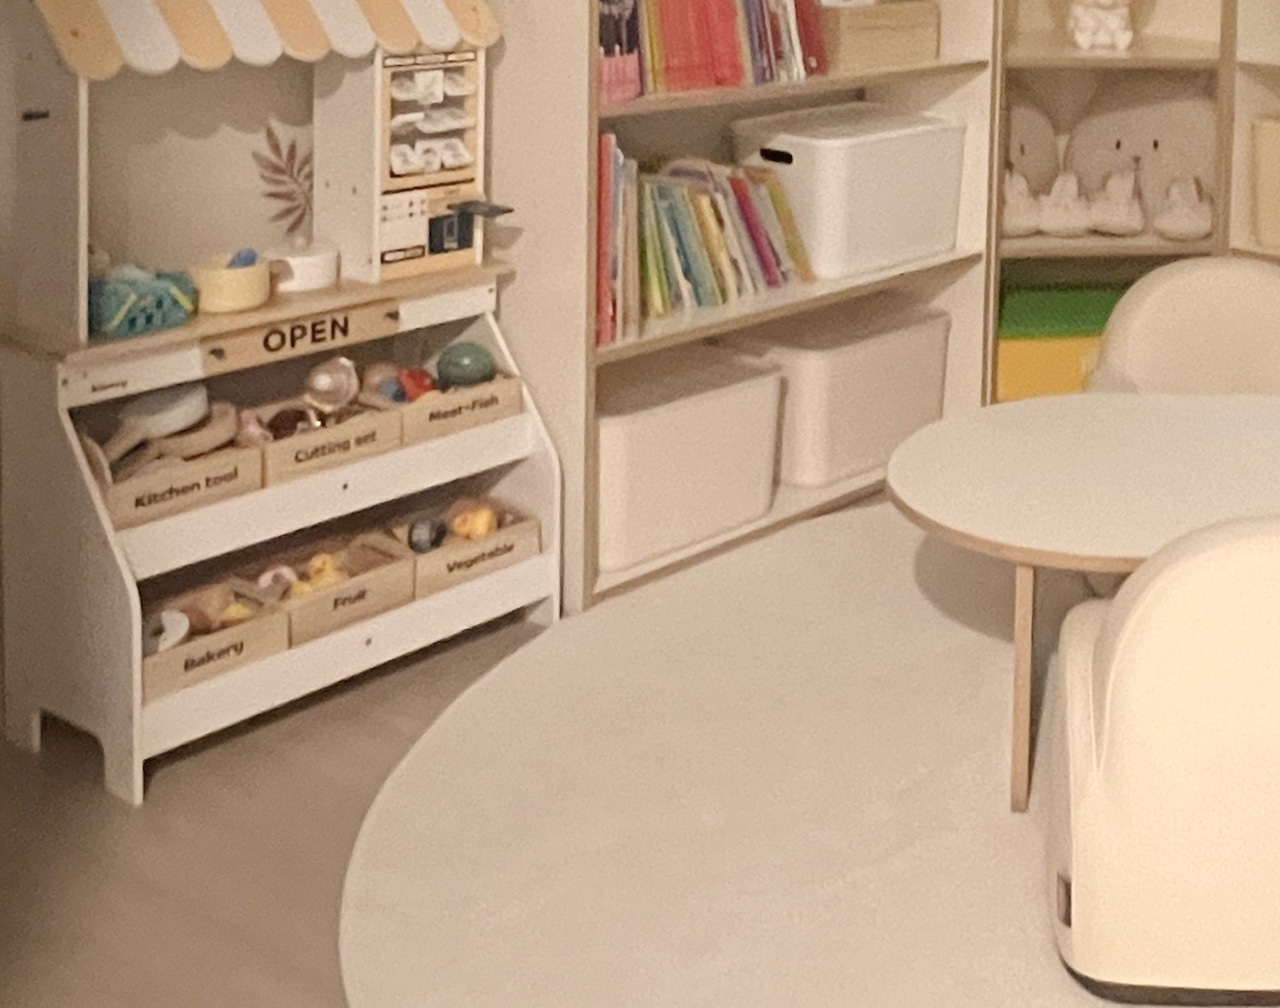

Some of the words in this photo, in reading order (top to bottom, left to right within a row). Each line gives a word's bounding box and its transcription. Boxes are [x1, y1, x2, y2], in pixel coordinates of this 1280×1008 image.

[263, 315, 349, 352] OPEN
[294, 439, 351, 464] Cutting
[135, 482, 200, 508] Kitchen
[205, 466, 238, 488] tool
[446, 542, 515, 573] Vegetable
[333, 588, 367, 610] Fruit
[184, 640, 244, 672] Bakery
